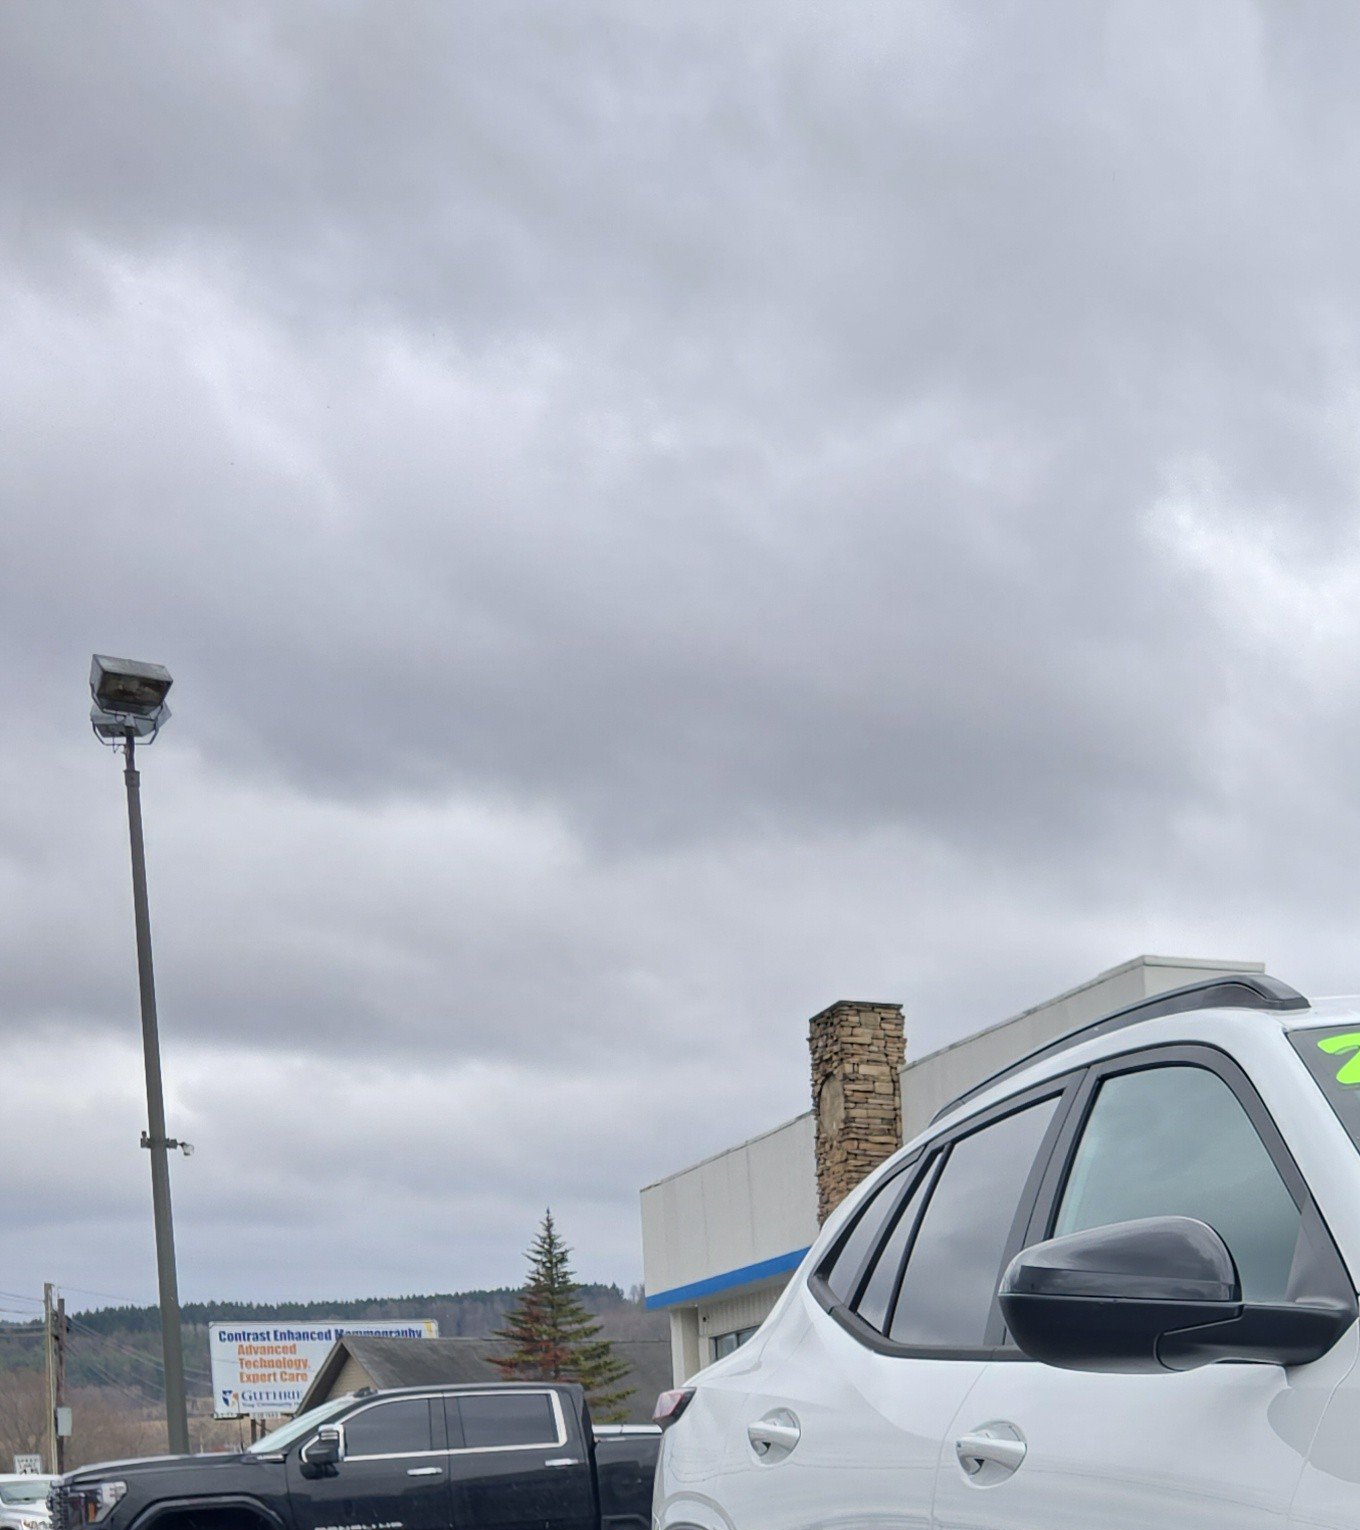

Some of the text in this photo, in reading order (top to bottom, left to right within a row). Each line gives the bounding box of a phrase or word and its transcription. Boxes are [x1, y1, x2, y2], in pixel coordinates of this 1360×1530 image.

[218, 1330, 271, 1343] Contrast
[273, 1329, 332, 1342] Enhanced
[237, 1343, 297, 1355] Advanced
[239, 1370, 308, 1384] Expert Care
